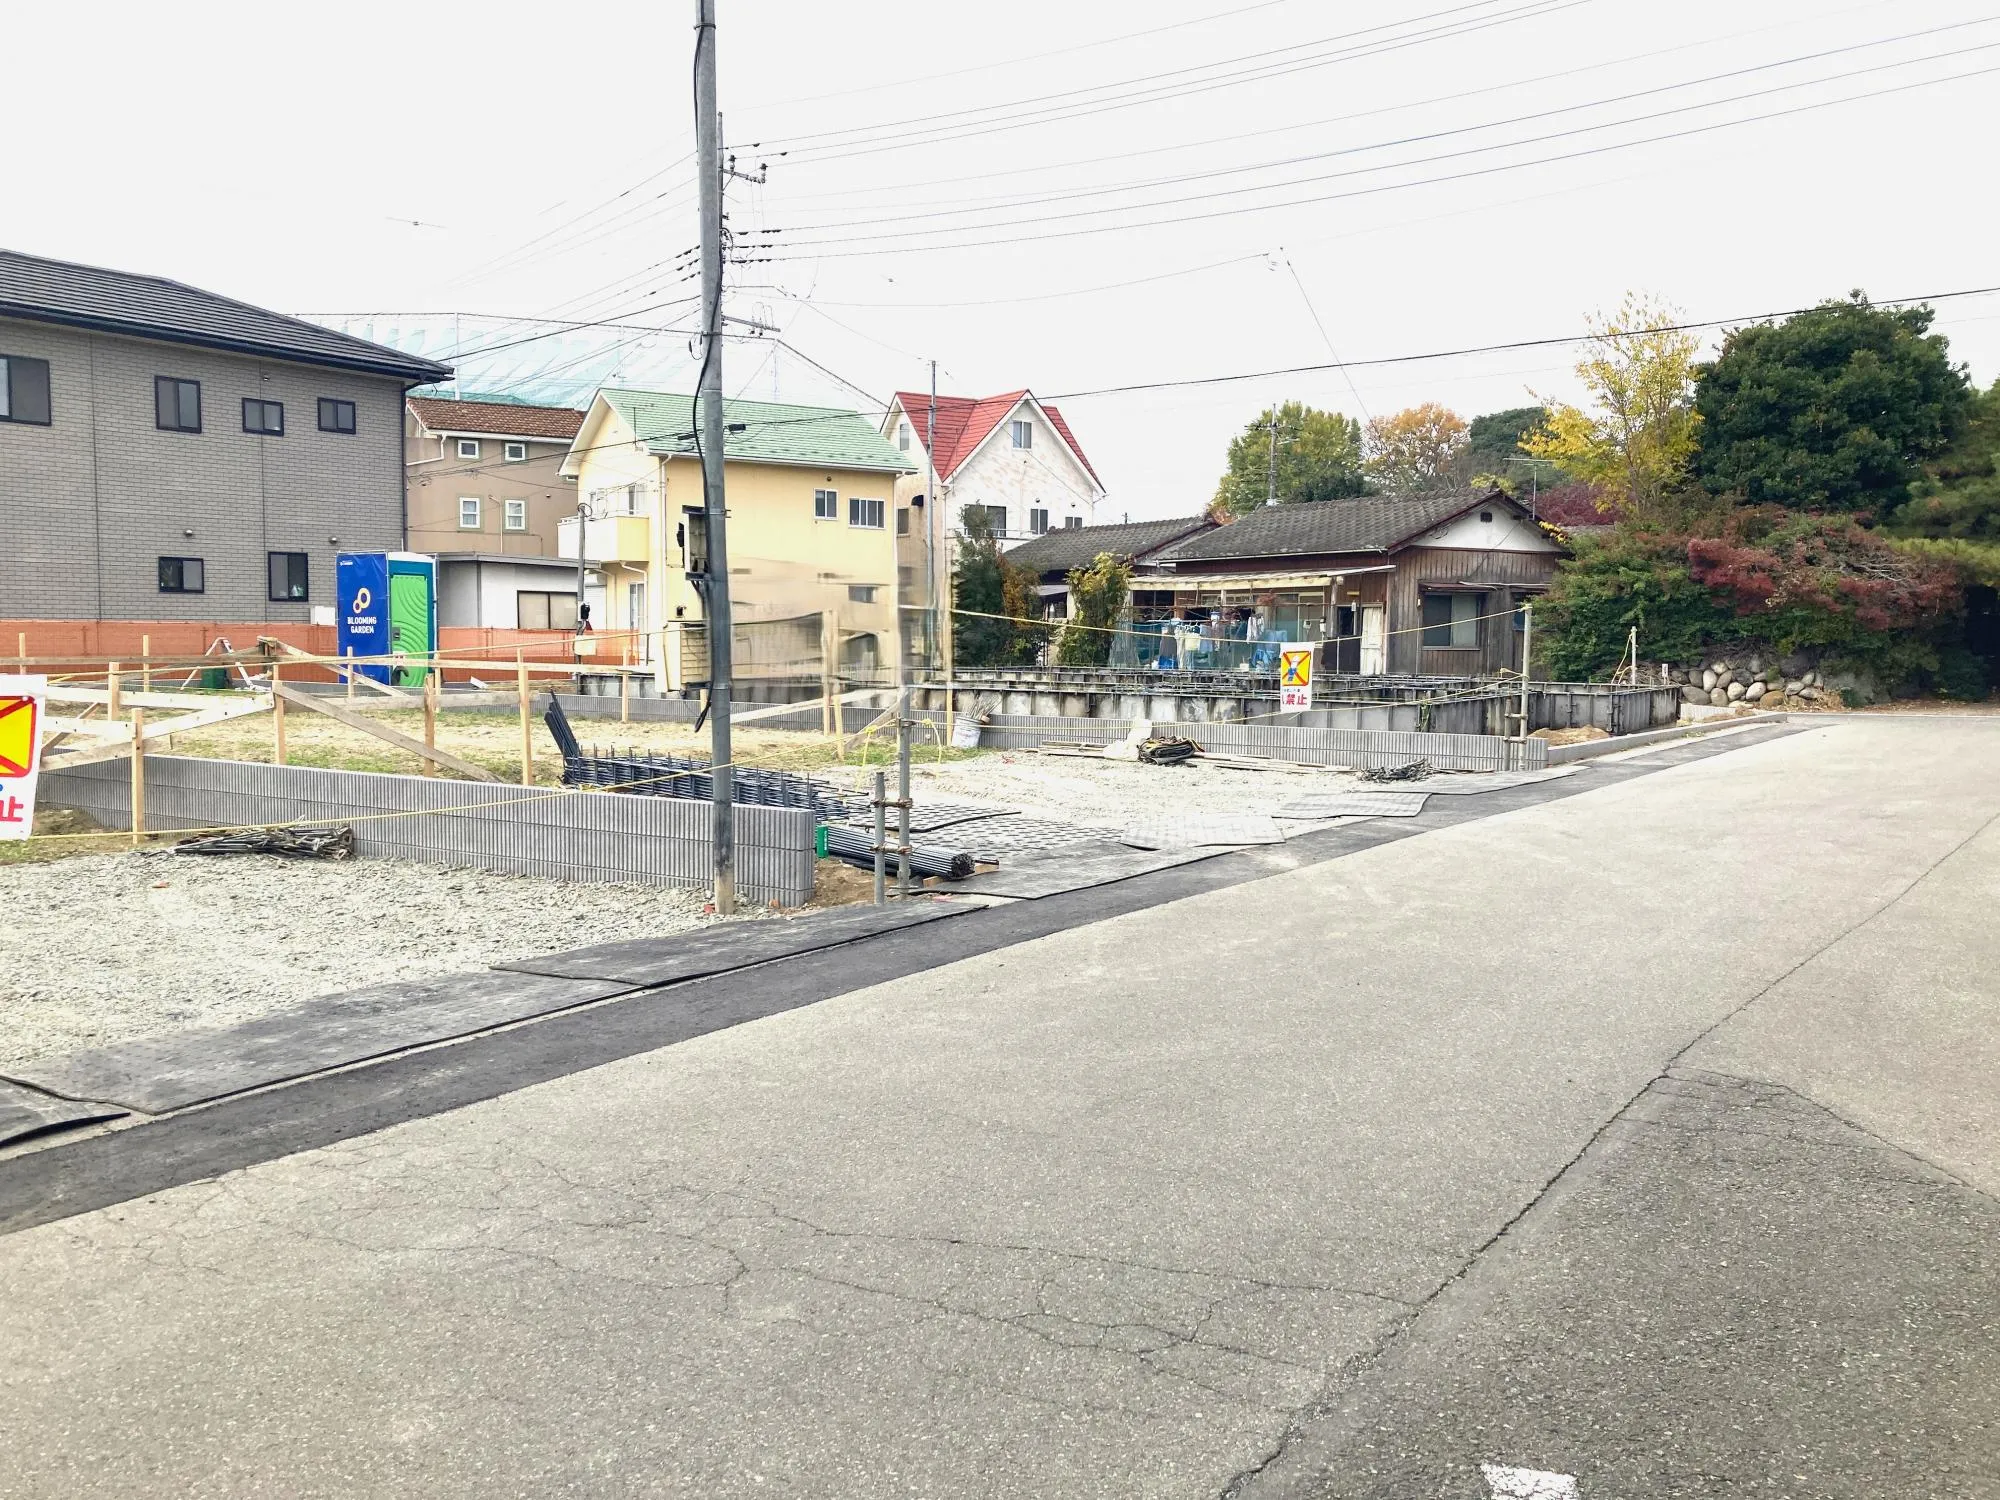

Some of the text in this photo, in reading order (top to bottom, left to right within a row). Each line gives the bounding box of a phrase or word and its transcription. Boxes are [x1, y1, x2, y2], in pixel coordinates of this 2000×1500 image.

[347, 616, 377, 625] BLOOMING
[350, 625, 375, 634] GARDEN
[1282, 693, 1308, 706] 禁止
